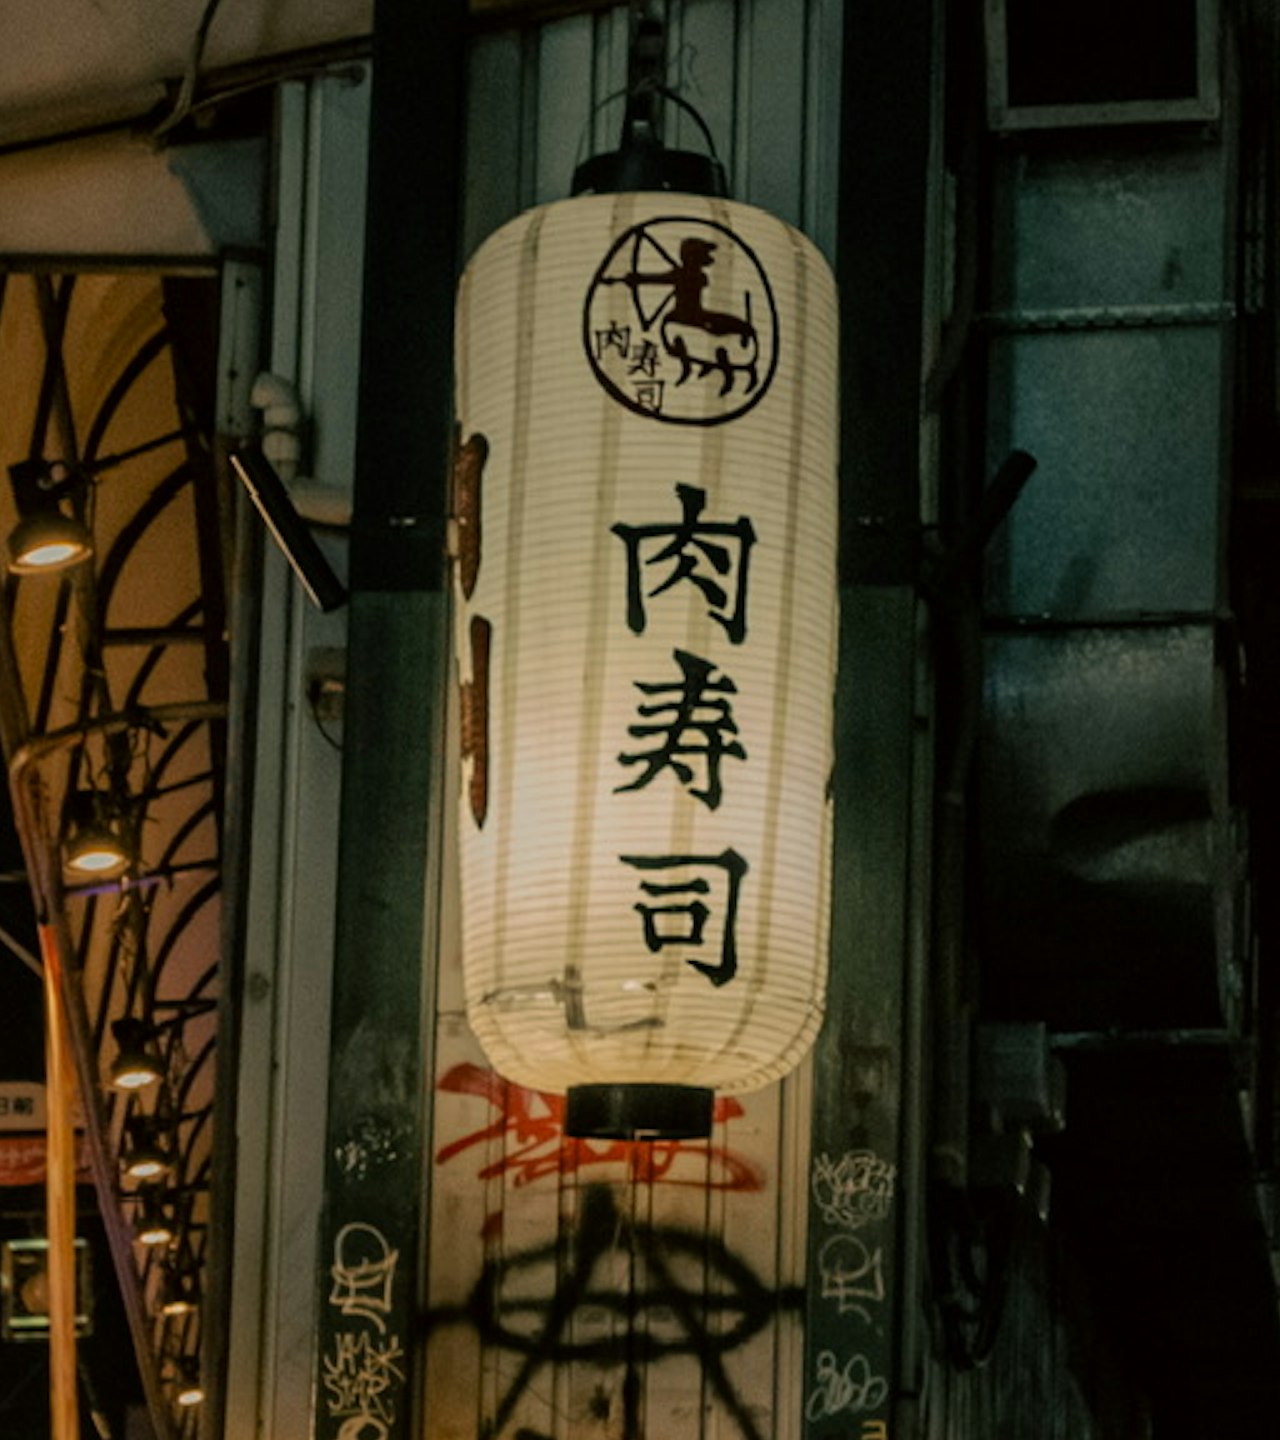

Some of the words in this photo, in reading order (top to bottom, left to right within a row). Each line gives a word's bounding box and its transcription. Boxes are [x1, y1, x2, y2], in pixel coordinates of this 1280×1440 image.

[595, 320, 665, 414] 肉寿司
[609, 482, 757, 988] 肉寿司
